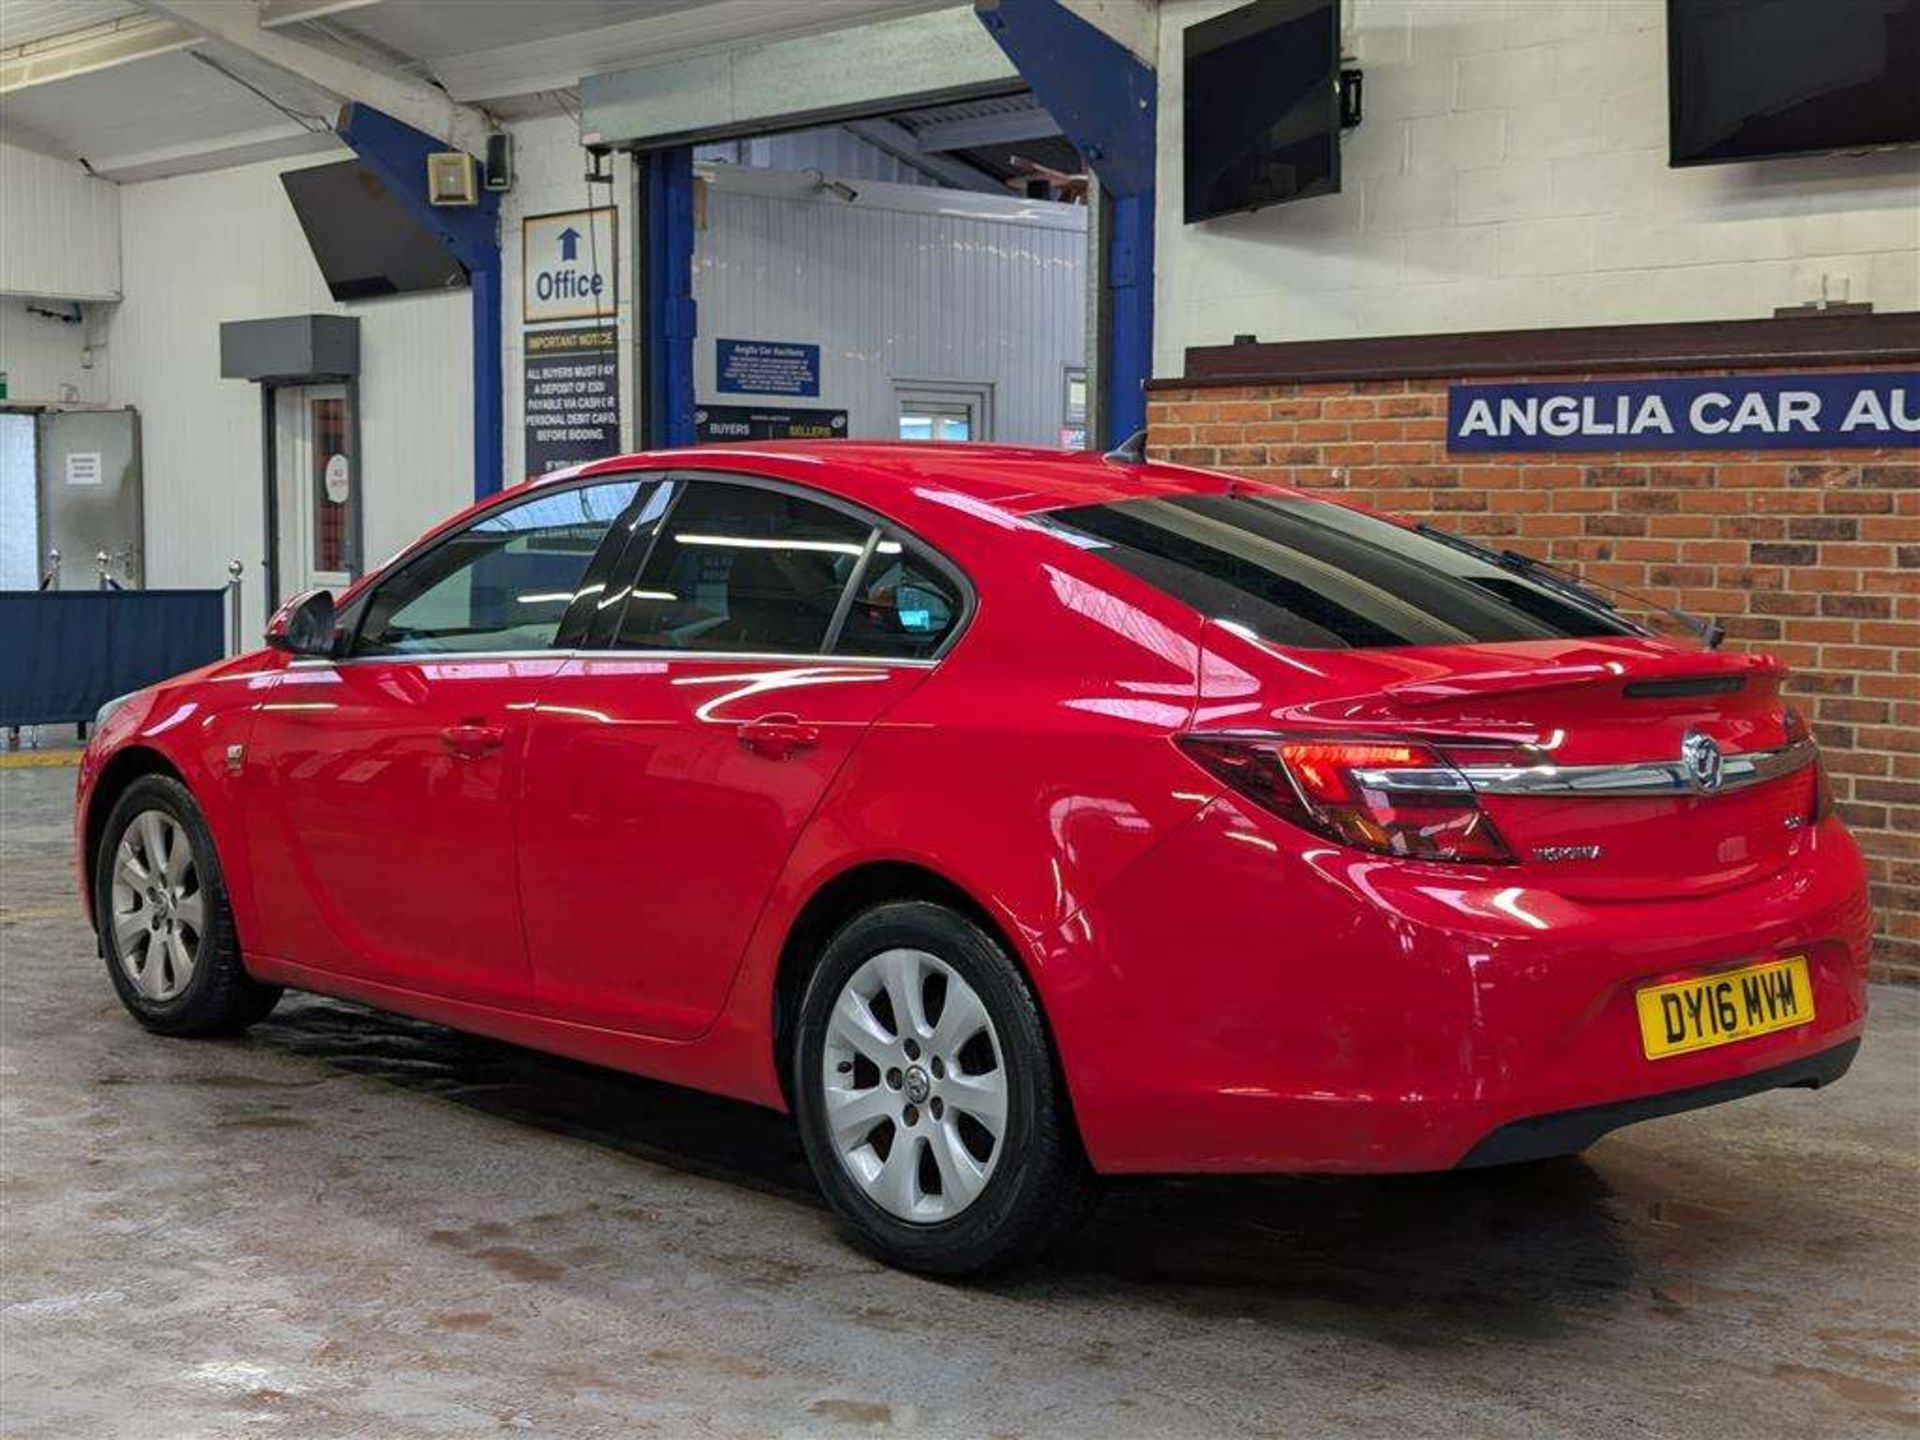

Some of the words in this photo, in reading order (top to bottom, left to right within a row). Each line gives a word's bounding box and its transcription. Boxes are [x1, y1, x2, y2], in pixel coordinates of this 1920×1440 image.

[537, 270, 603, 300] Office
[528, 335, 577, 349] IMPORTANT
[527, 368, 541, 379] ALL
[542, 366, 573, 379] BUYERS
[575, 365, 596, 378] MUST
[534, 384, 540, 394] A
[541, 382, 573, 395] DEPOSIT
[575, 381, 586, 393] OF
[528, 398, 562, 411] PAYABLE
[563, 398, 577, 410] VIA
[527, 413, 566, 427] PERSONAL
[567, 413, 590, 425] DEBIT
[1459, 395, 1674, 437] ANGLIA
[1689, 391, 1821, 434] CAR
[537, 428, 567, 441] BEFORE
[710, 423, 750, 436] BUYERS
[789, 425, 831, 437] SELLERS
[1661, 982, 1738, 1044] DY16
[1741, 967, 1797, 1027] MVM
